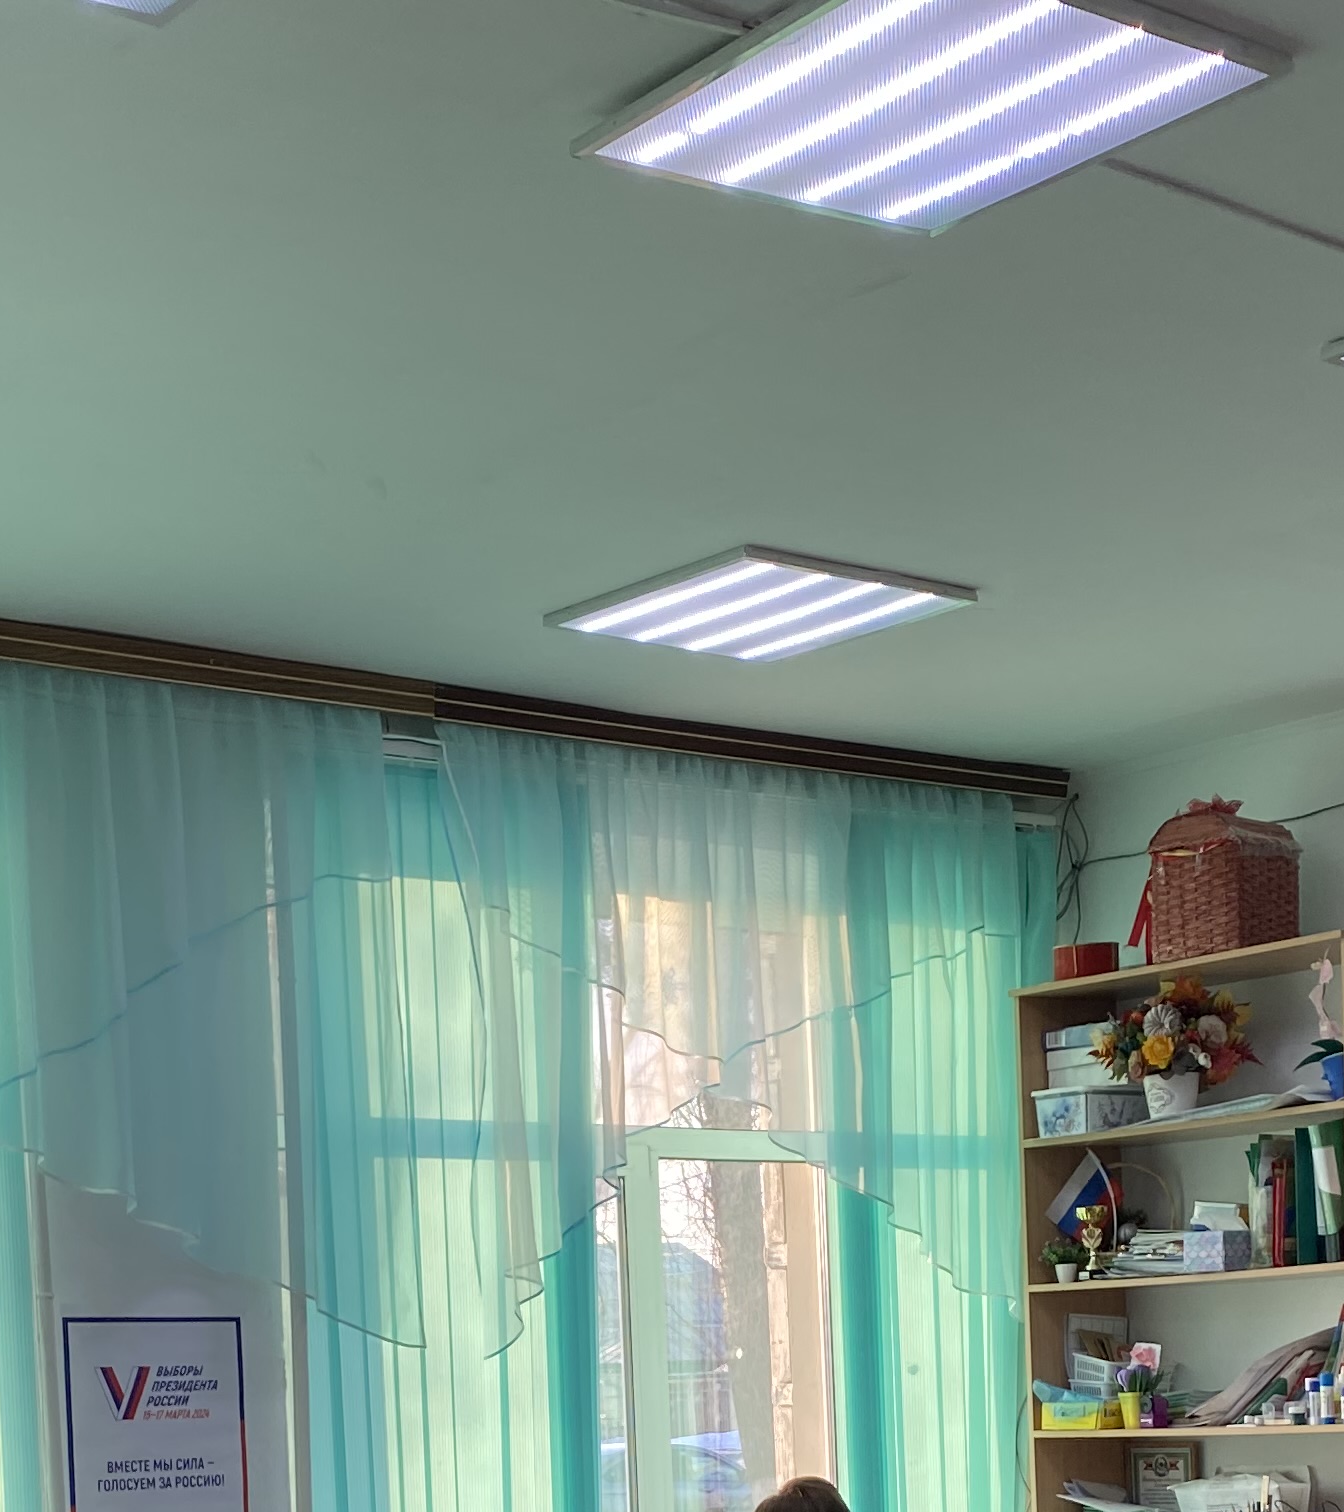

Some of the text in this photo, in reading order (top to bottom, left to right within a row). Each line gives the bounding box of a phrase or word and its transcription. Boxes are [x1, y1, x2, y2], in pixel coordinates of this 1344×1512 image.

[156, 1365, 204, 1377] ВЫБОРЫ
[151, 1380, 218, 1392] ПРЕЗИДЕНТА
[146, 1395, 190, 1407] РОССИИ
[165, 1409, 190, 1419] МАРТА
[192, 1408, 210, 1418] 2024
[107, 1460, 150, 1473] ВМЕСТЕ
[153, 1459, 173, 1472] МЫ
[176, 1457, 204, 1470] СИЛА
[97, 1474, 225, 1492] ГОЛОСУЕМ ЗА РОССИЮ!
